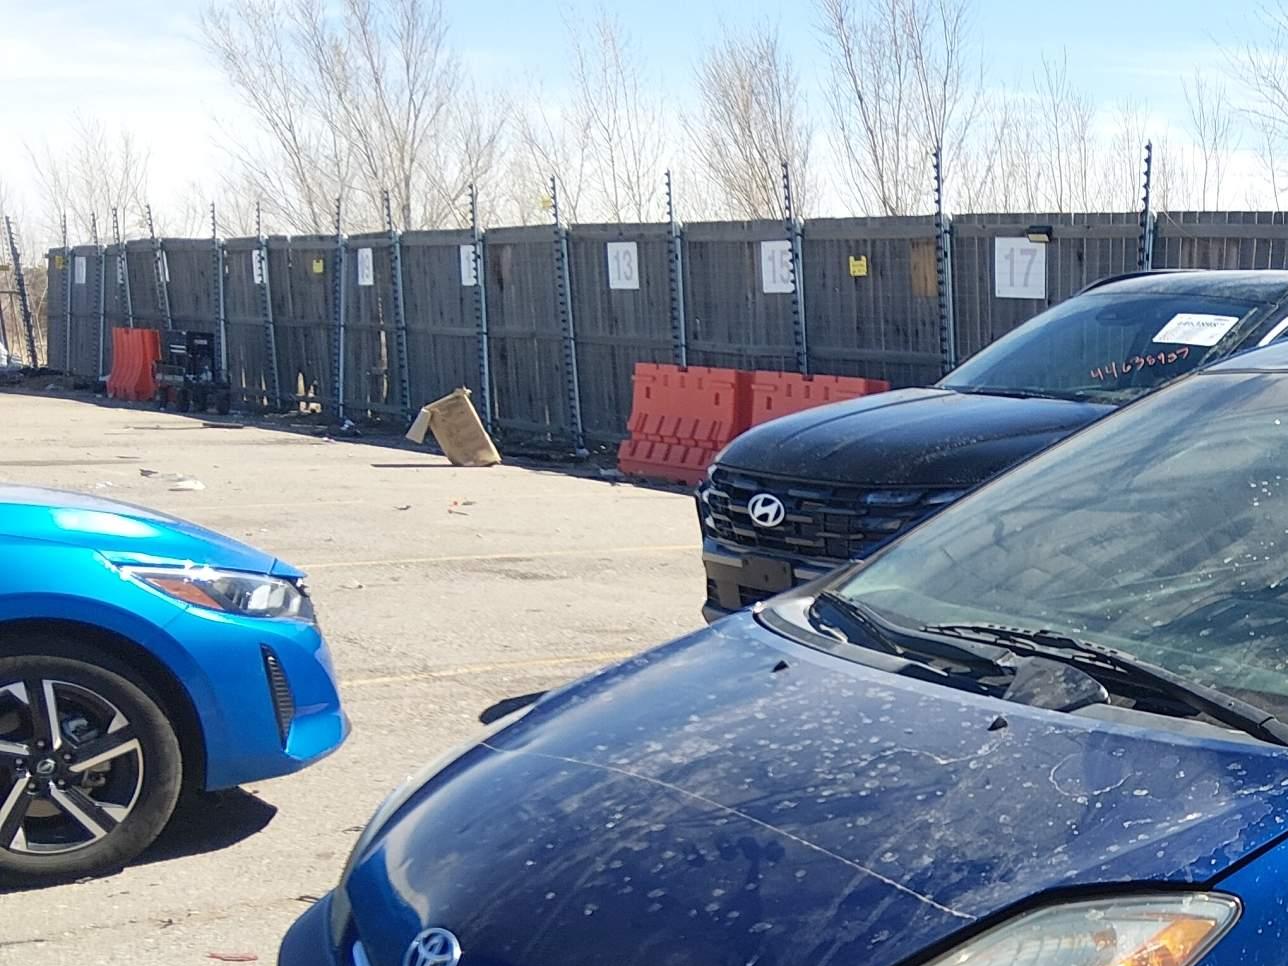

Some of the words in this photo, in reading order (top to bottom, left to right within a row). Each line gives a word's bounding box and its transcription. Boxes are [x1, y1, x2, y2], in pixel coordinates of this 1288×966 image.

[614, 249, 633, 281] 13
[768, 249, 792, 284] 15
[1003, 247, 1038, 288] 17
